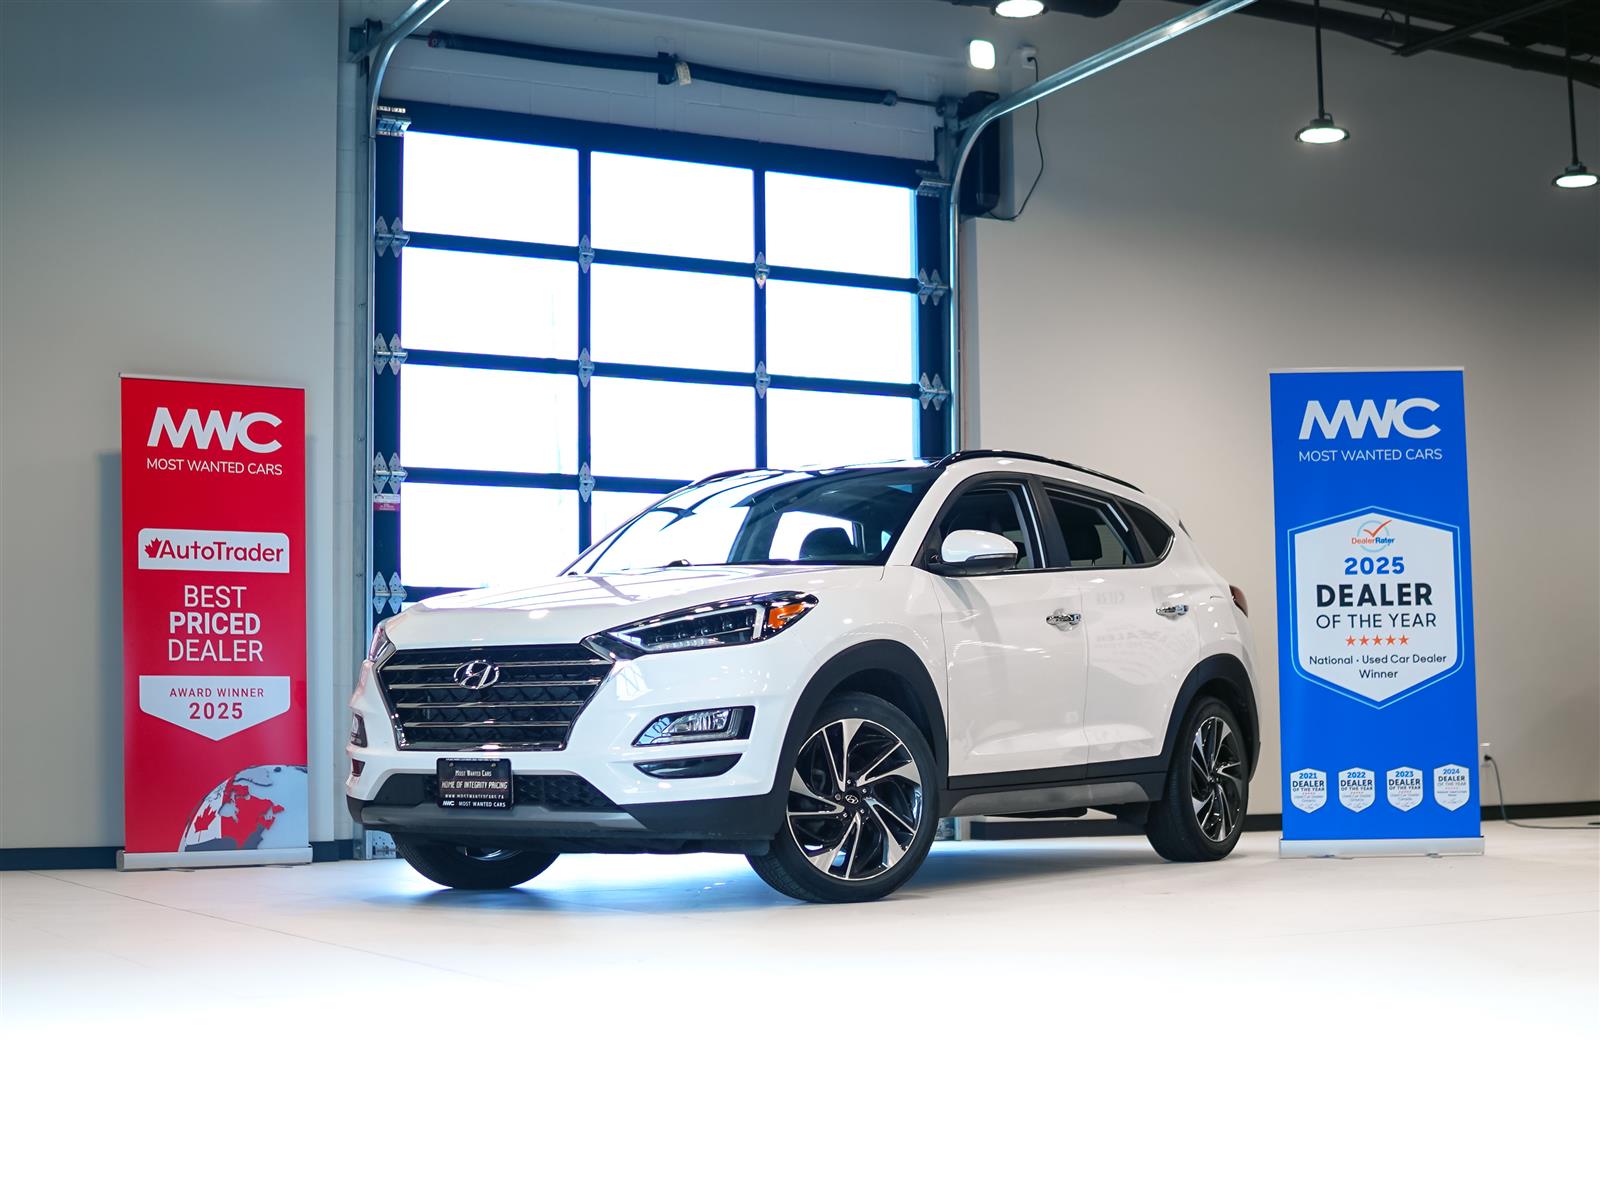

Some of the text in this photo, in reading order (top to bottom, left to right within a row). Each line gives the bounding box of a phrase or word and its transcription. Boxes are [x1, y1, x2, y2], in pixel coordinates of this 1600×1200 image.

[1298, 397, 1441, 440] MWC
[147, 406, 282, 453] MWC
[1299, 448, 1443, 462] MOST WANTED CARS
[146, 458, 283, 476] MOST WANTED CARS
[1351, 537, 1395, 545] DealerRater
[159, 539, 284, 562] AutoTrader
[1344, 556, 1405, 575] 2025
[184, 585, 247, 608] BEST
[1316, 583, 1433, 607] DEALER
[169, 611, 261, 635] PRICED
[1316, 612, 1437, 628] OF THE YEAR
[168, 639, 263, 662] DEALER
[1309, 654, 1447, 665] National Used Car Dealer
[1359, 669, 1398, 678] Winner
[169, 687, 264, 697] AWARD WINNER
[189, 702, 243, 719] 2025
[441, 781, 508, 790] HOME OF INTEGRITY PRICING
